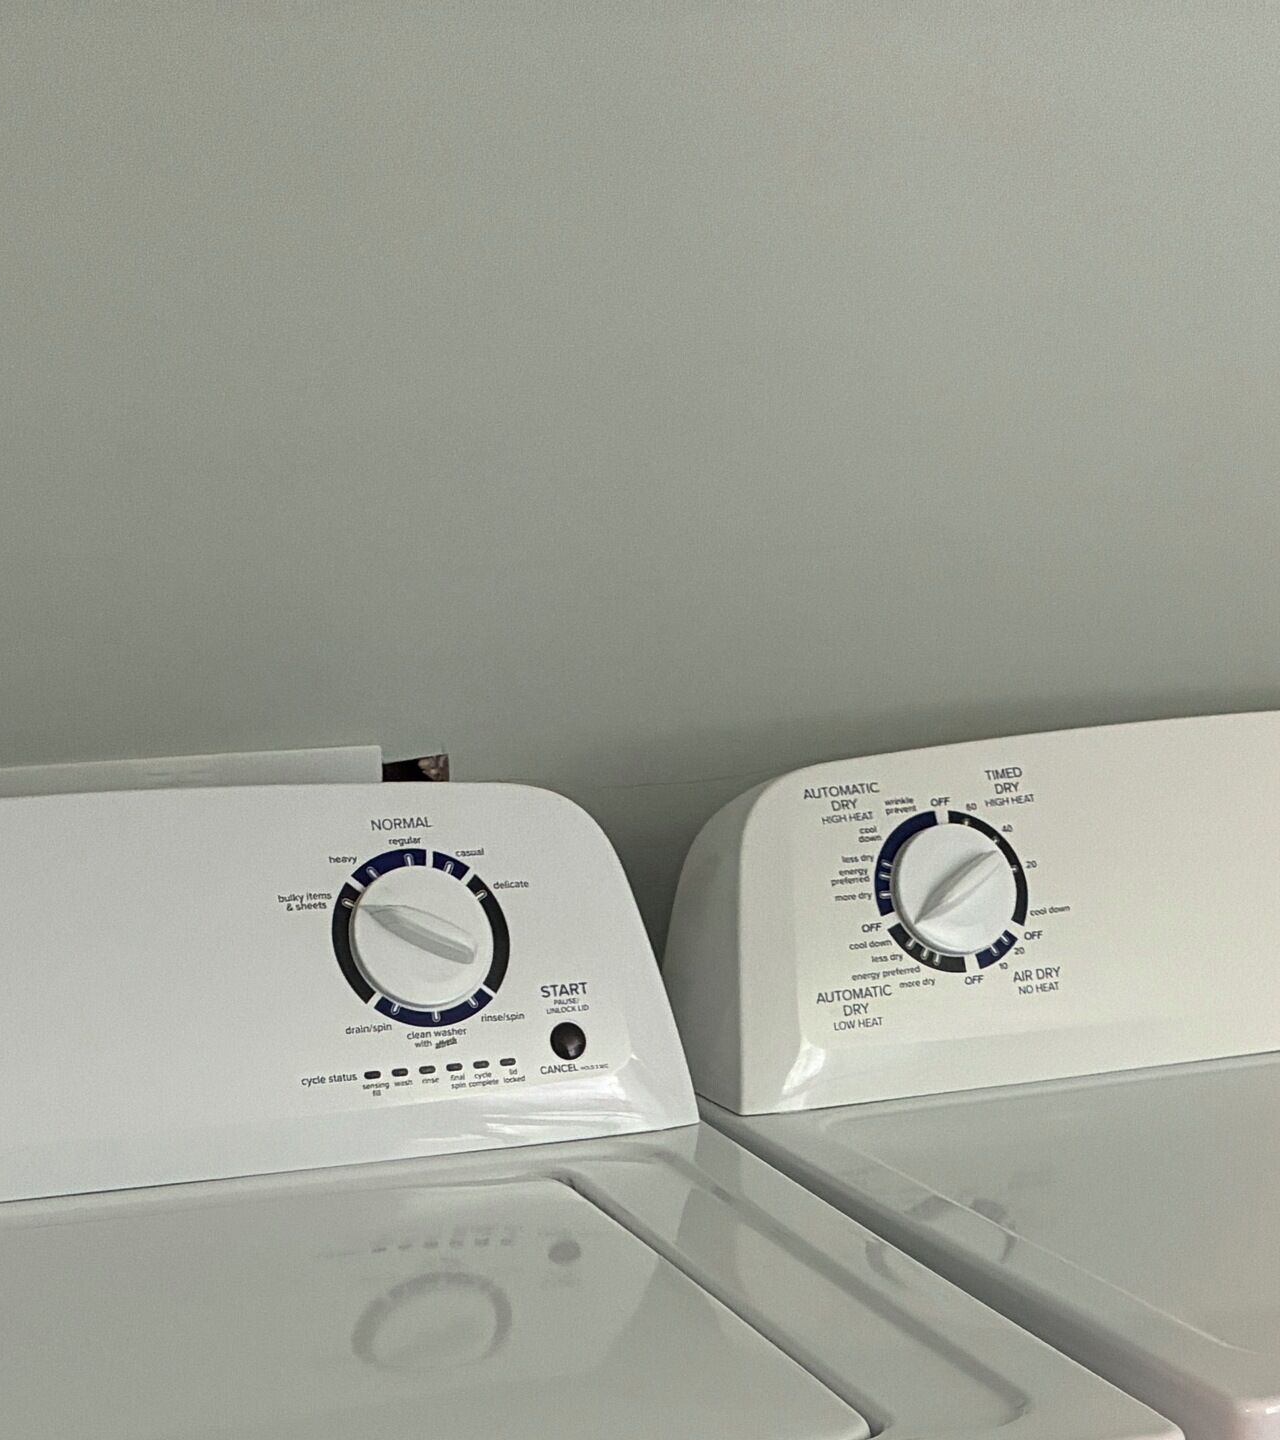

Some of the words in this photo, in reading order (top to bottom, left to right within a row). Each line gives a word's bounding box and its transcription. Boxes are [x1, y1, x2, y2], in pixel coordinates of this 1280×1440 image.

[985, 767, 1022, 780] TIMED
[803, 782, 880, 800] AUTOMATIC
[995, 782, 1019, 794] DRY
[832, 799, 857, 811] DRY
[931, 797, 950, 807] OFF
[985, 797, 1007, 807] HIGH
[1010, 794, 1034, 804] HEAT
[822, 814, 847, 824] HIGH
[849, 812, 873, 821] HEAT
[371, 817, 432, 831] NORMAL
[860, 826, 877, 834] cool
[388, 836, 421, 846] regular
[329, 855, 357, 865] heavy
[842, 855, 858, 863] less
[861, 855, 874, 864] dry
[1026, 861, 1037, 869] 20
[839, 868, 868, 878] energy
[493, 880, 529, 889] delicate
[831, 875, 870, 886] preferred
[278, 894, 303, 904] bulky
[306, 892, 332, 901] items
[835, 894, 857, 902] more
[859, 892, 872, 902] dry
[286, 903, 293, 911] &
[295, 901, 327, 910] sheets
[1030, 908, 1046, 916] cool
[1048, 905, 1070, 914] down
[862, 923, 882, 934] OFF
[1024, 931, 1043, 941] OFF
[849, 942, 865, 950] cool
[868, 939, 892, 948] down
[890, 954, 903, 963] dry
[852, 971, 880, 982] energy
[883, 966, 920, 978] preferred
[1013, 971, 1033, 983] AIR
[1036, 967, 1060, 980] DRY
[923, 978, 935, 988] dry
[964, 976, 984, 986] OFF
[541, 982, 587, 998] START
[1018, 986, 1033, 995] NO
[1036, 982, 1059, 992] HEAT
[816, 985, 892, 1004] AUTOMATIC
[546, 1005, 576, 1014] UNLOCK
[843, 1004, 869, 1016] DRY
[481, 1012, 525, 1024] rinse/spin
[834, 1021, 854, 1030] LOW
[857, 1017, 883, 1028] HEAT
[345, 1023, 392, 1036] drain/spin
[407, 1031, 431, 1040] clean
[434, 1028, 467, 1037] washer
[415, 1039, 432, 1048] with
[540, 1064, 578, 1074] CANCEL
[301, 1076, 326, 1088] cycle
[328, 1073, 357, 1083] status
[474, 1071, 492, 1080] cycle
[503, 1075, 525, 1083] locked
[362, 1081, 390, 1090] sensing
[451, 1082, 467, 1090] spin
[469, 1079, 499, 1088] complete
